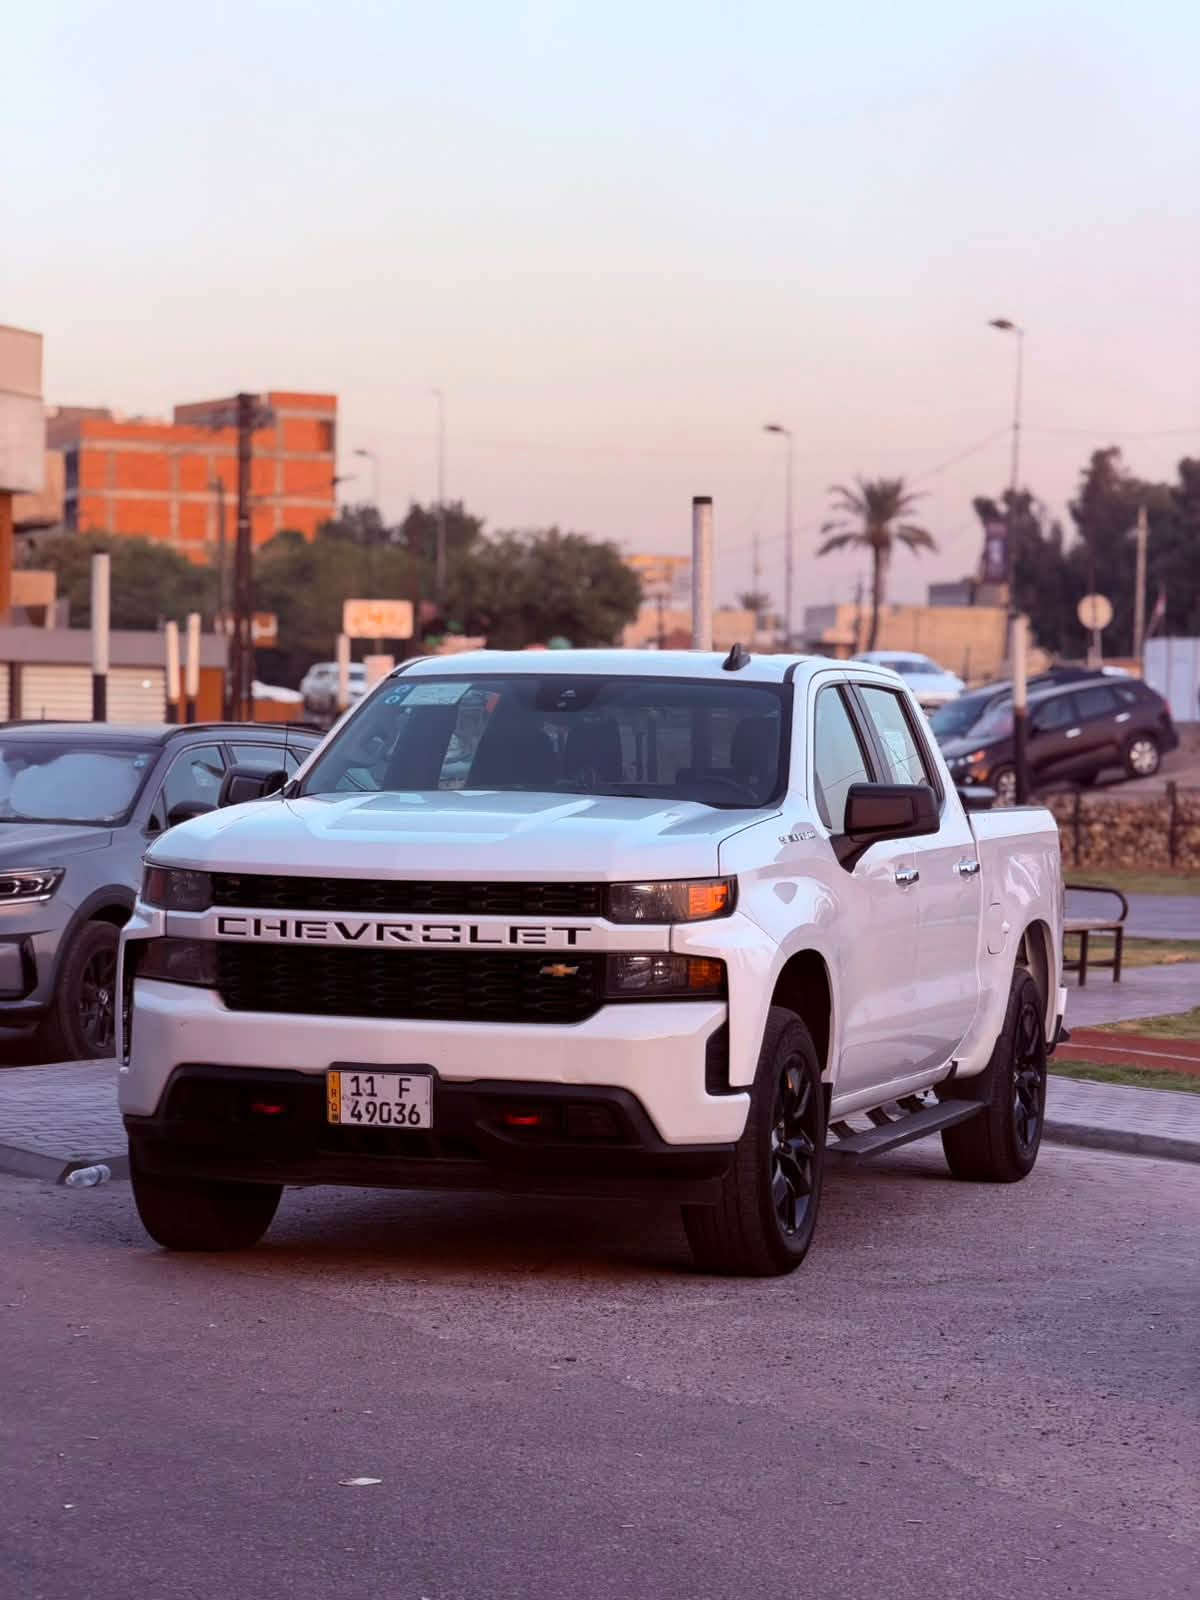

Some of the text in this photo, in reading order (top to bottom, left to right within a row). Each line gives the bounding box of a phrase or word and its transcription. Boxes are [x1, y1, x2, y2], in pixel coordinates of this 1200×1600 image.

[216, 916, 592, 946] CHEVROLET
[350, 1075, 412, 1099] 11 F
[350, 1100, 421, 1125] 49036
